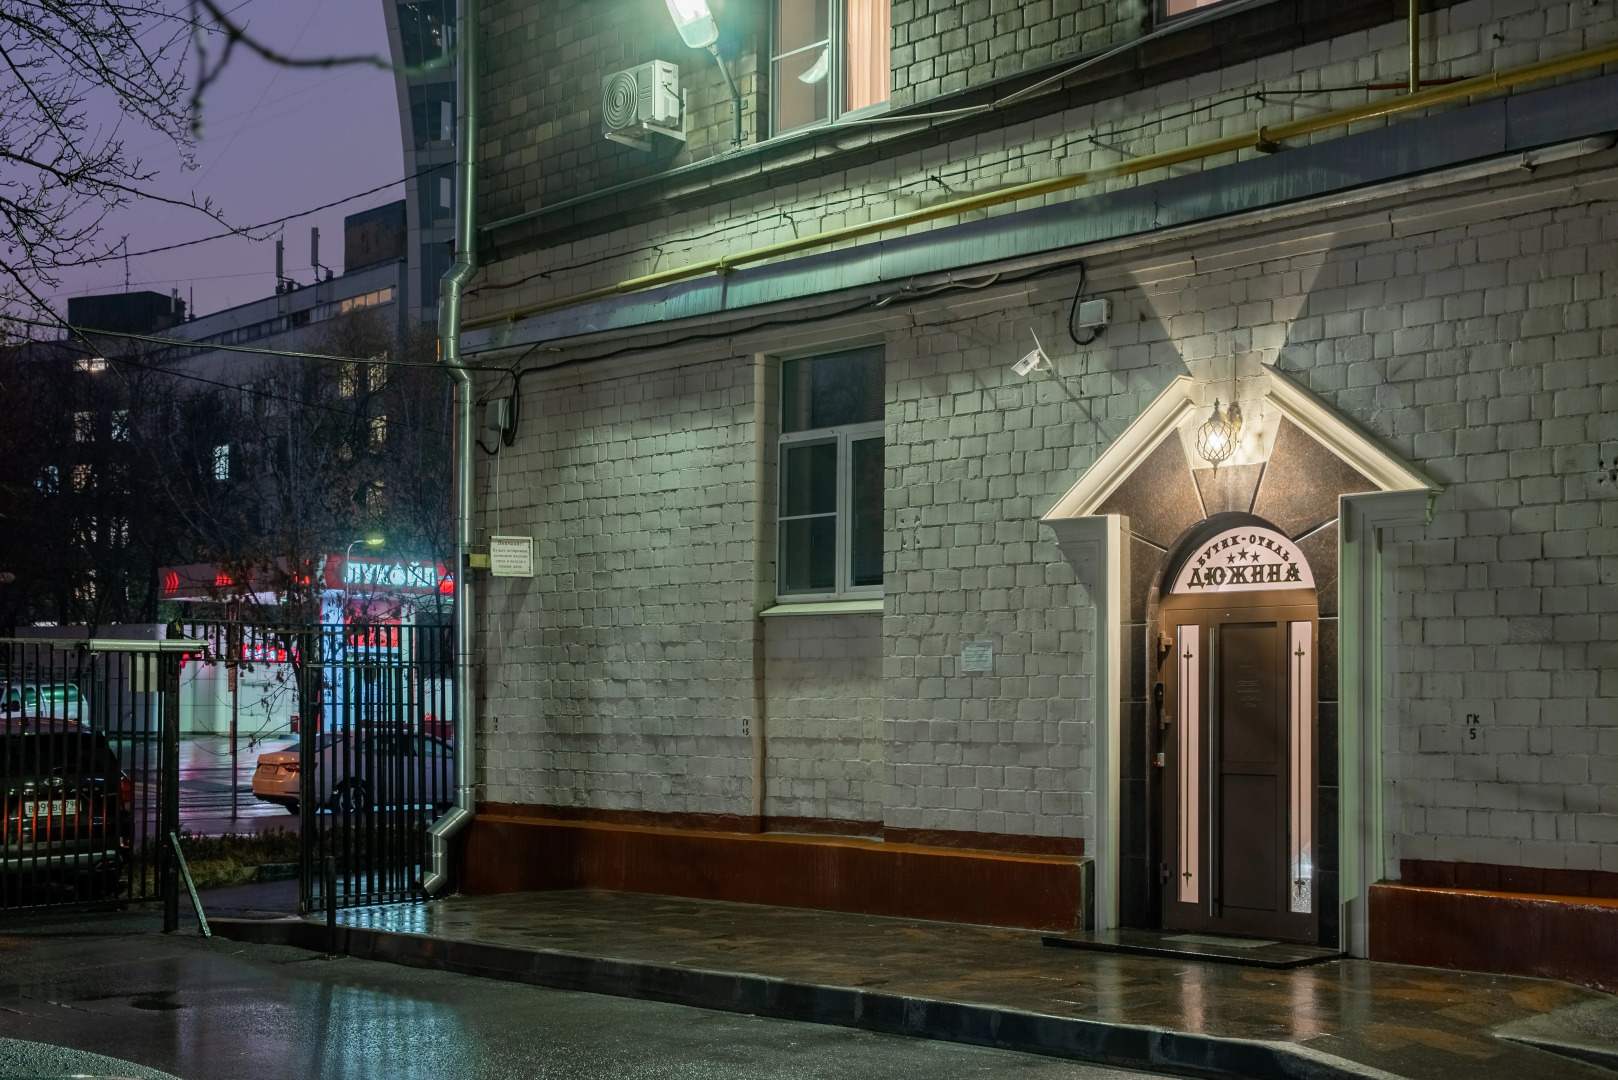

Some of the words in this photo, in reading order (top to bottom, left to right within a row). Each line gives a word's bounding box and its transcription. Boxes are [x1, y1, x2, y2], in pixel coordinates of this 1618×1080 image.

[343, 561, 437, 587] ЛУКОЙЛ
[1187, 562, 1302, 589] ДЮЖИНА
[1466, 714, 1480, 725] ГК
[1469, 728, 1476, 740] 5
